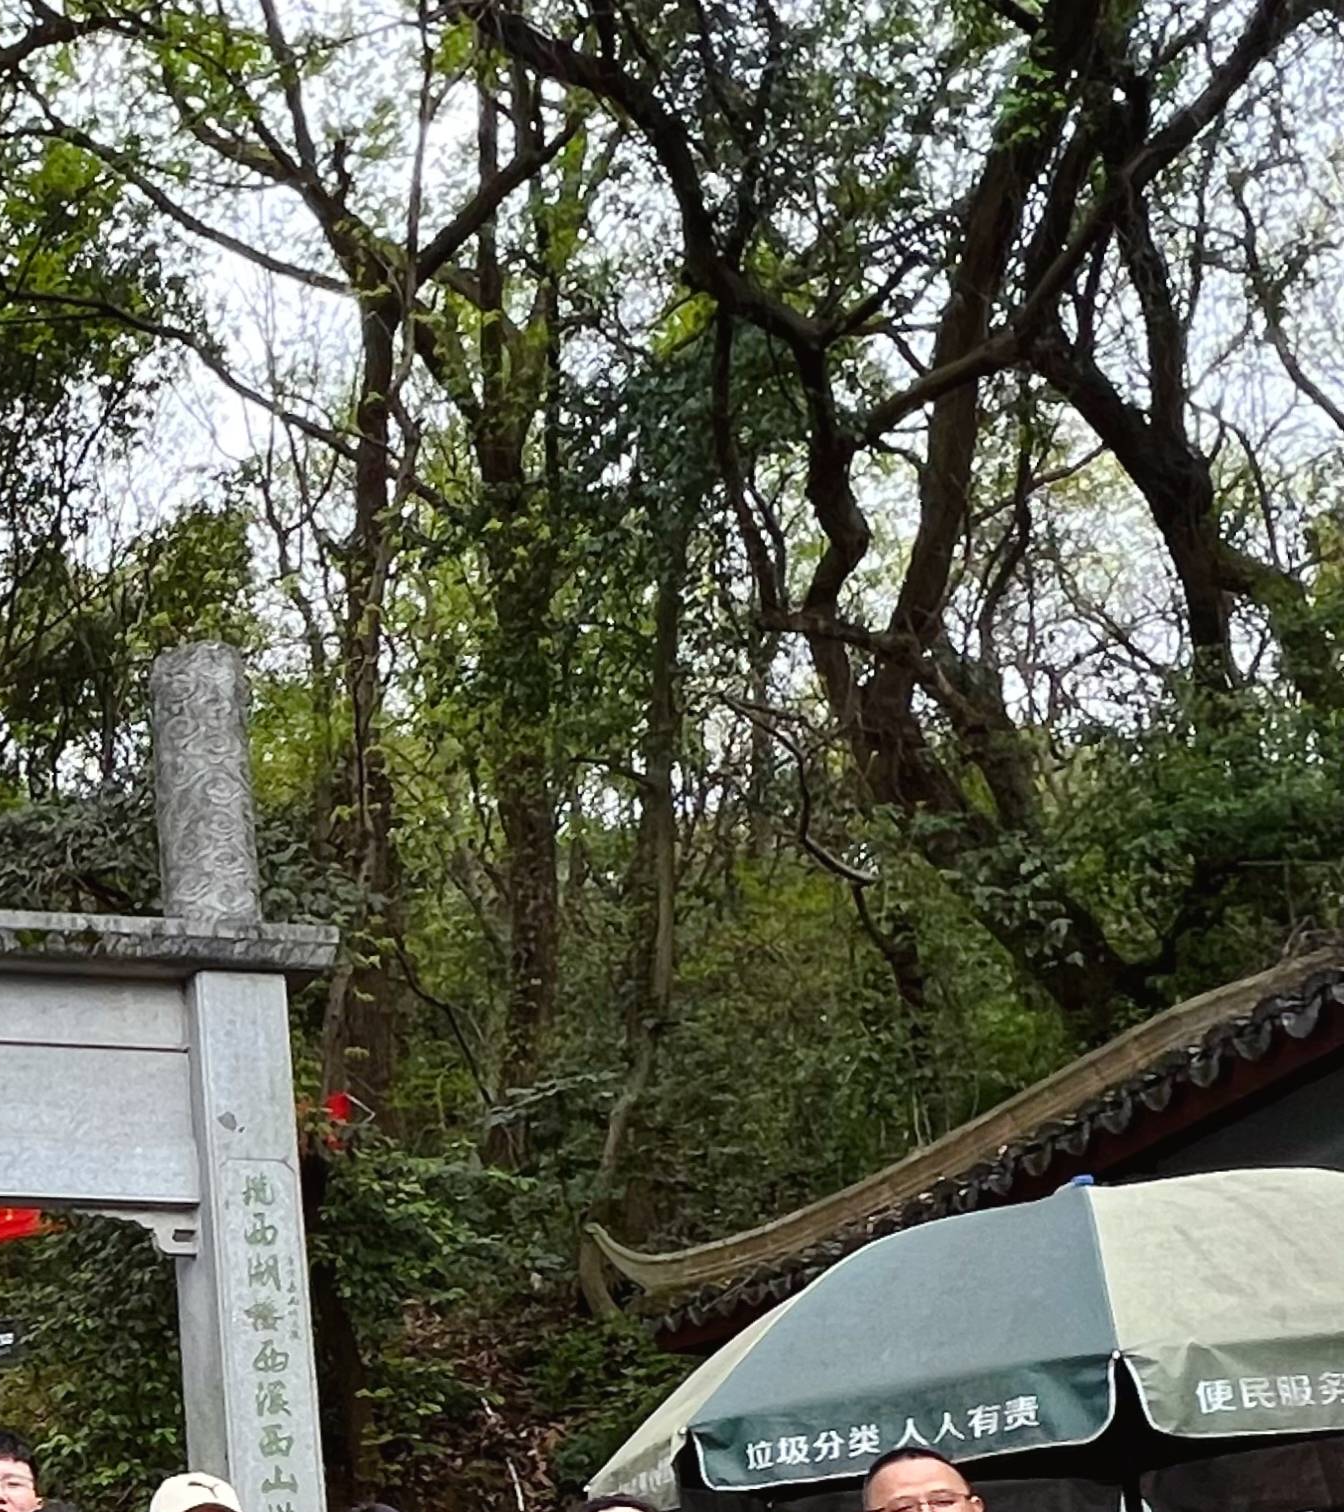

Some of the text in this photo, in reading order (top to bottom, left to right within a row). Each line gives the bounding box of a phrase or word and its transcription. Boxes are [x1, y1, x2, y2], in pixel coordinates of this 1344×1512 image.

[745, 1395, 1041, 1471] 垃圾分类 人人有责
